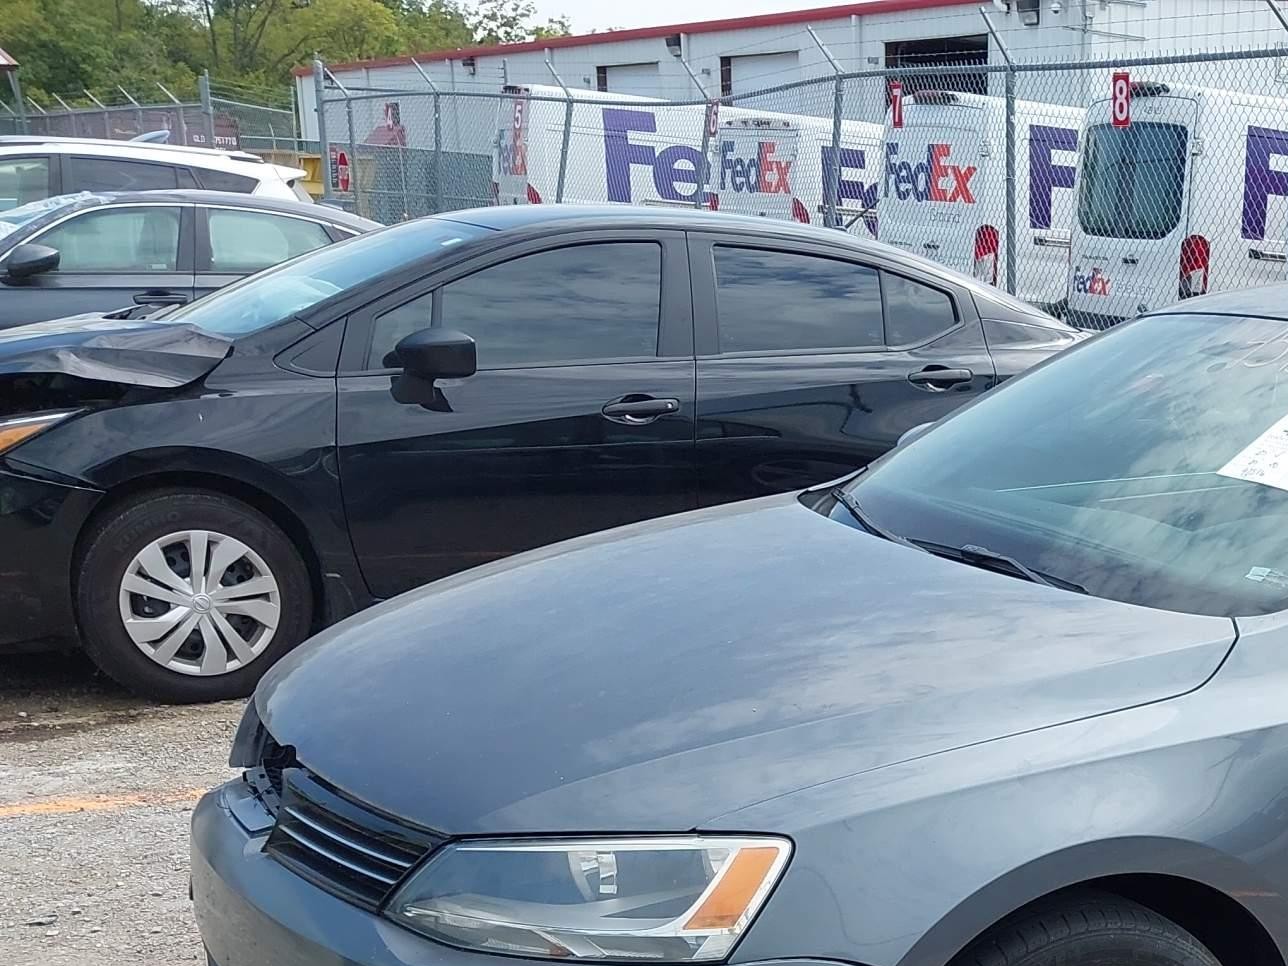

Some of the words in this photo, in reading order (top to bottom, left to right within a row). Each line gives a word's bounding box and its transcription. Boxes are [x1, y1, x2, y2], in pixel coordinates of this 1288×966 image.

[514, 104, 522, 129] 5
[1114, 79, 1129, 121] 8
[602, 107, 718, 204] Fe
[720, 140, 792, 194] FedEx
[884, 142, 977, 204] FedEx
[1072, 265, 1111, 297] FedEx
